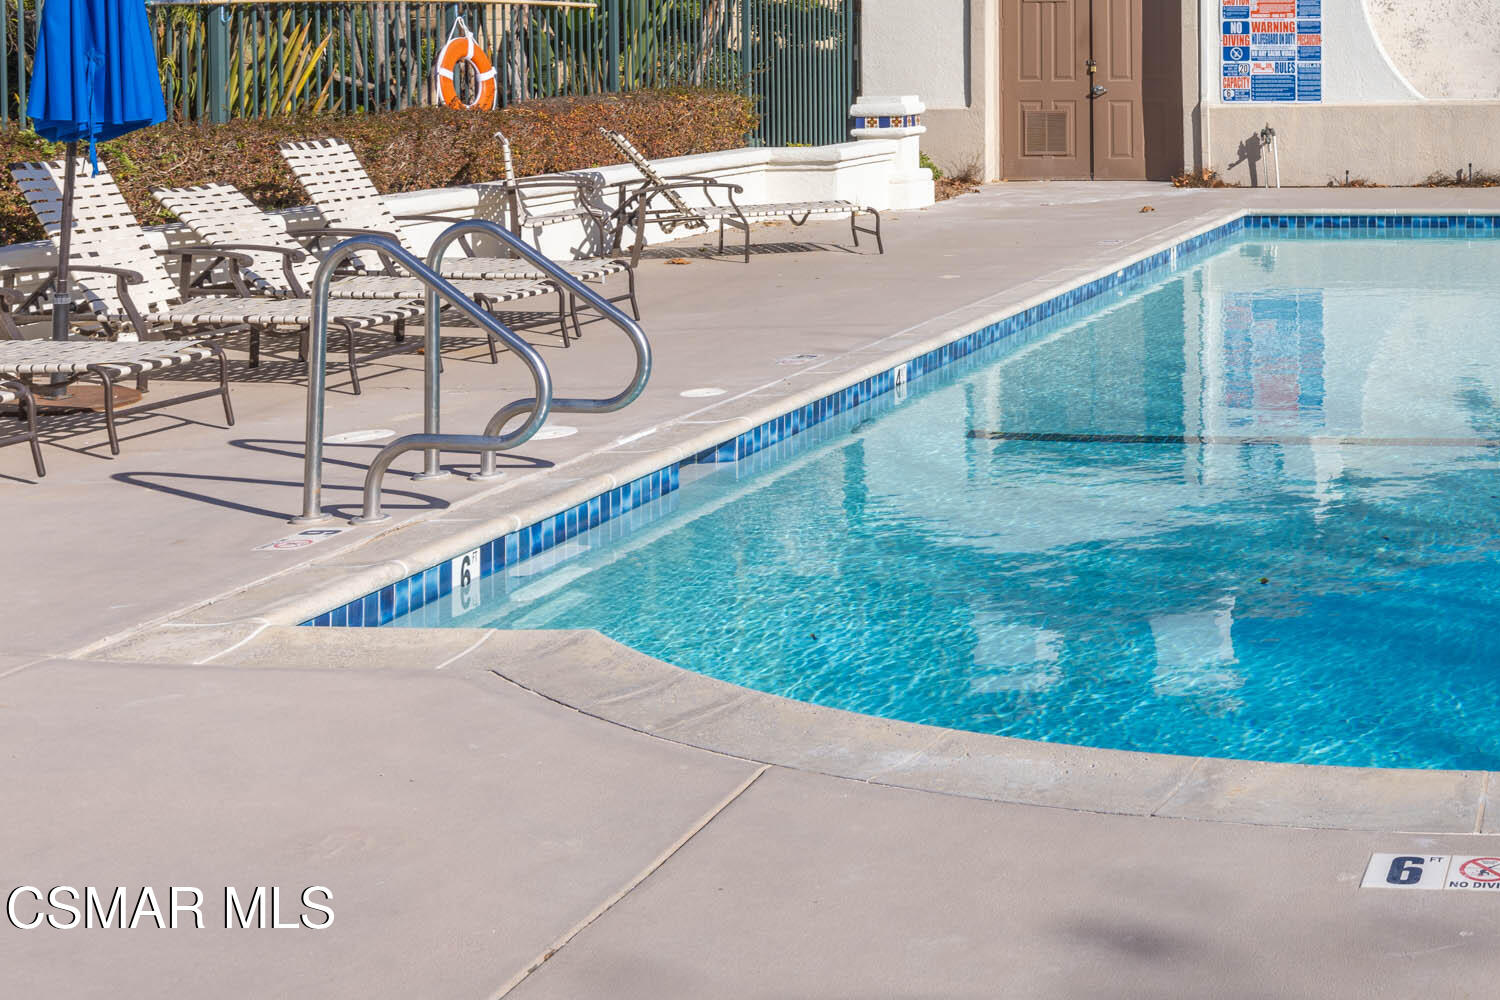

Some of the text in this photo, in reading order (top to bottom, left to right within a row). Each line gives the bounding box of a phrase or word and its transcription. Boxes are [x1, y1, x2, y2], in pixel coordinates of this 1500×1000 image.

[1230, 22, 1242, 34] NO
[1251, 21, 1295, 33] WARNING
[1223, 34, 1250, 46] DIVING
[1239, 64, 1248, 73] 20
[1274, 62, 1295, 74] RULES
[1223, 77, 1250, 89] CAPACITY
[460, 555, 471, 587] 6
[1386, 856, 1425, 885] 6
